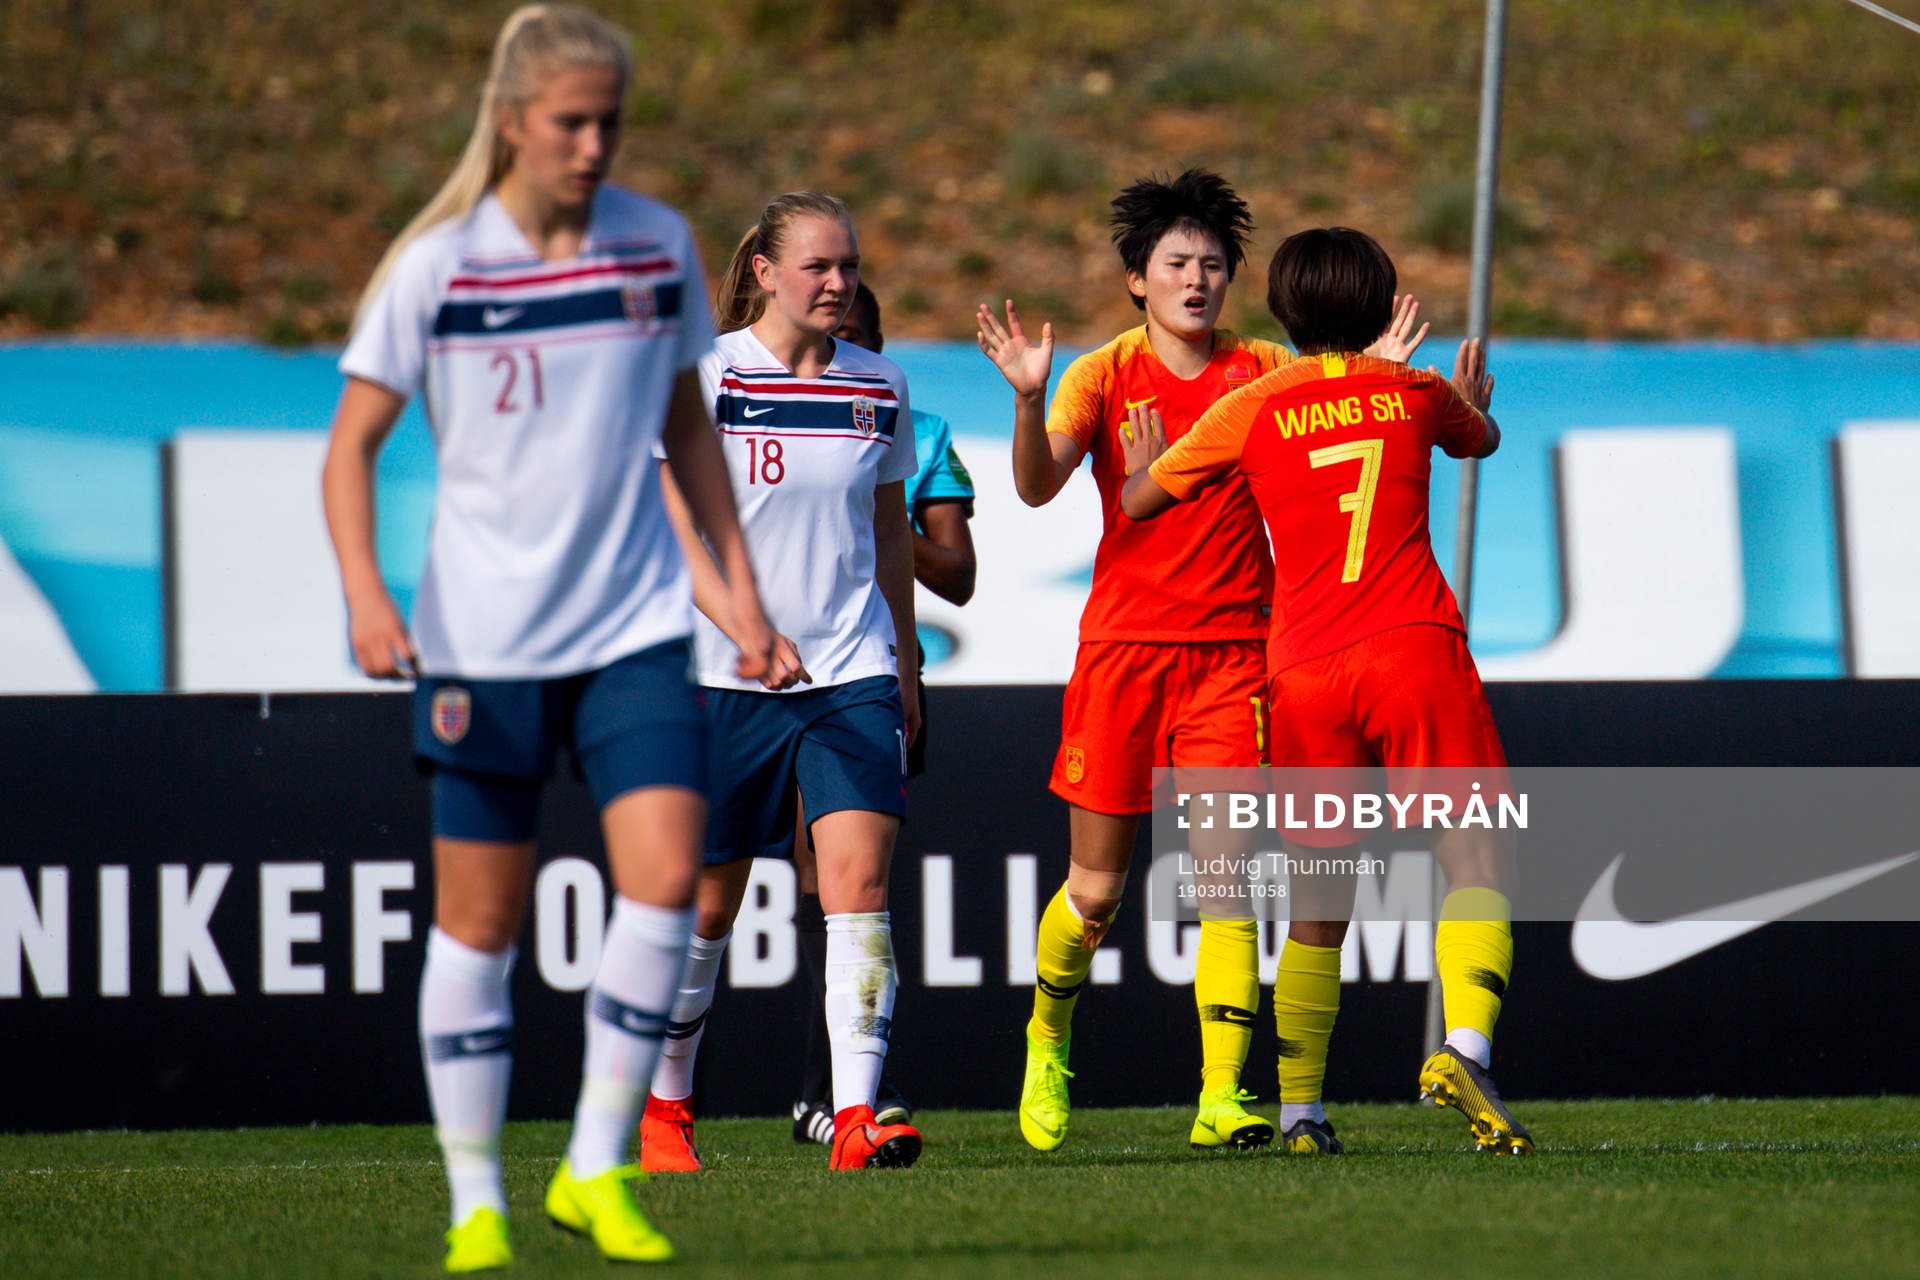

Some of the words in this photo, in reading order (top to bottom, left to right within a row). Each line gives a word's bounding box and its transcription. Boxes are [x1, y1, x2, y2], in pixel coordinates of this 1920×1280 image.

[490, 347, 543, 414] 21
[1274, 396, 1363, 440] WANG
[1372, 392, 1412, 422] SH.
[745, 437, 785, 485] 18
[1308, 438, 1384, 584] 7
